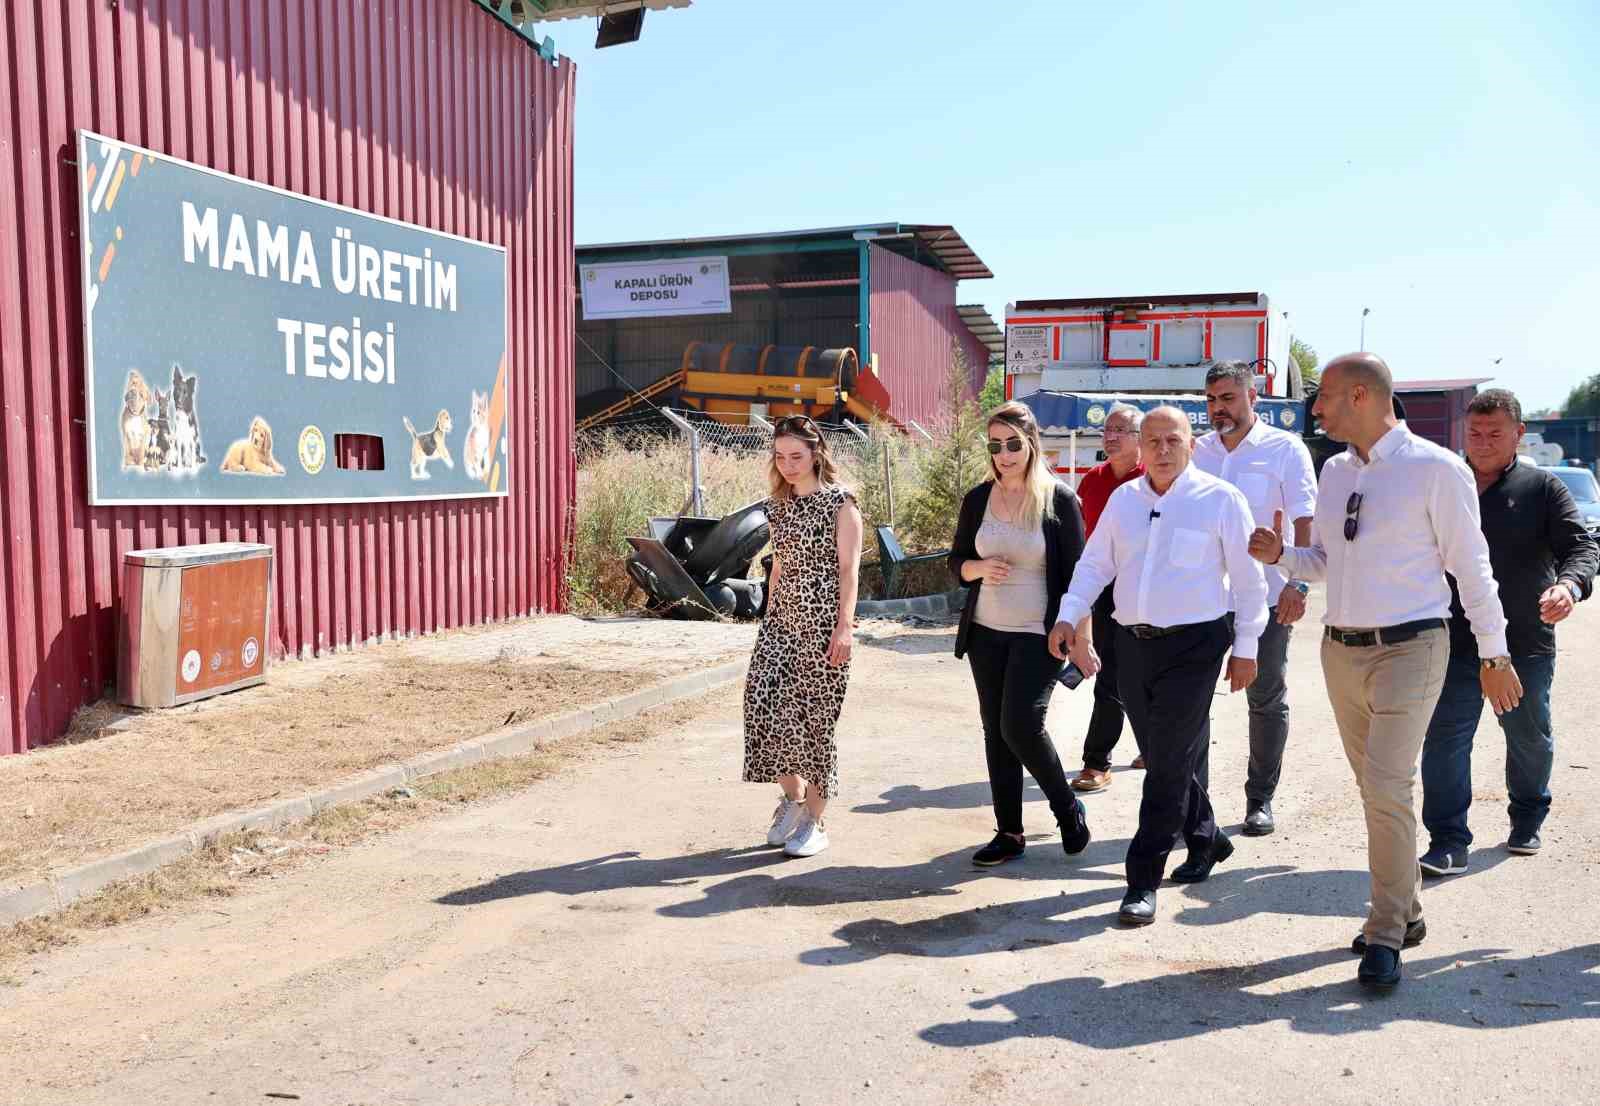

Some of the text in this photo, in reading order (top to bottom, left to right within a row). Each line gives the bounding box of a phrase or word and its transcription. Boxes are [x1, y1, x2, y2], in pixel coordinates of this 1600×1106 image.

[182, 200, 457, 312] MAMA ÜRETİM
[614, 273, 693, 290] KAPALI ÜRÜN
[630, 290, 678, 301] DEPOSU
[277, 316, 396, 384] TESİSİ
